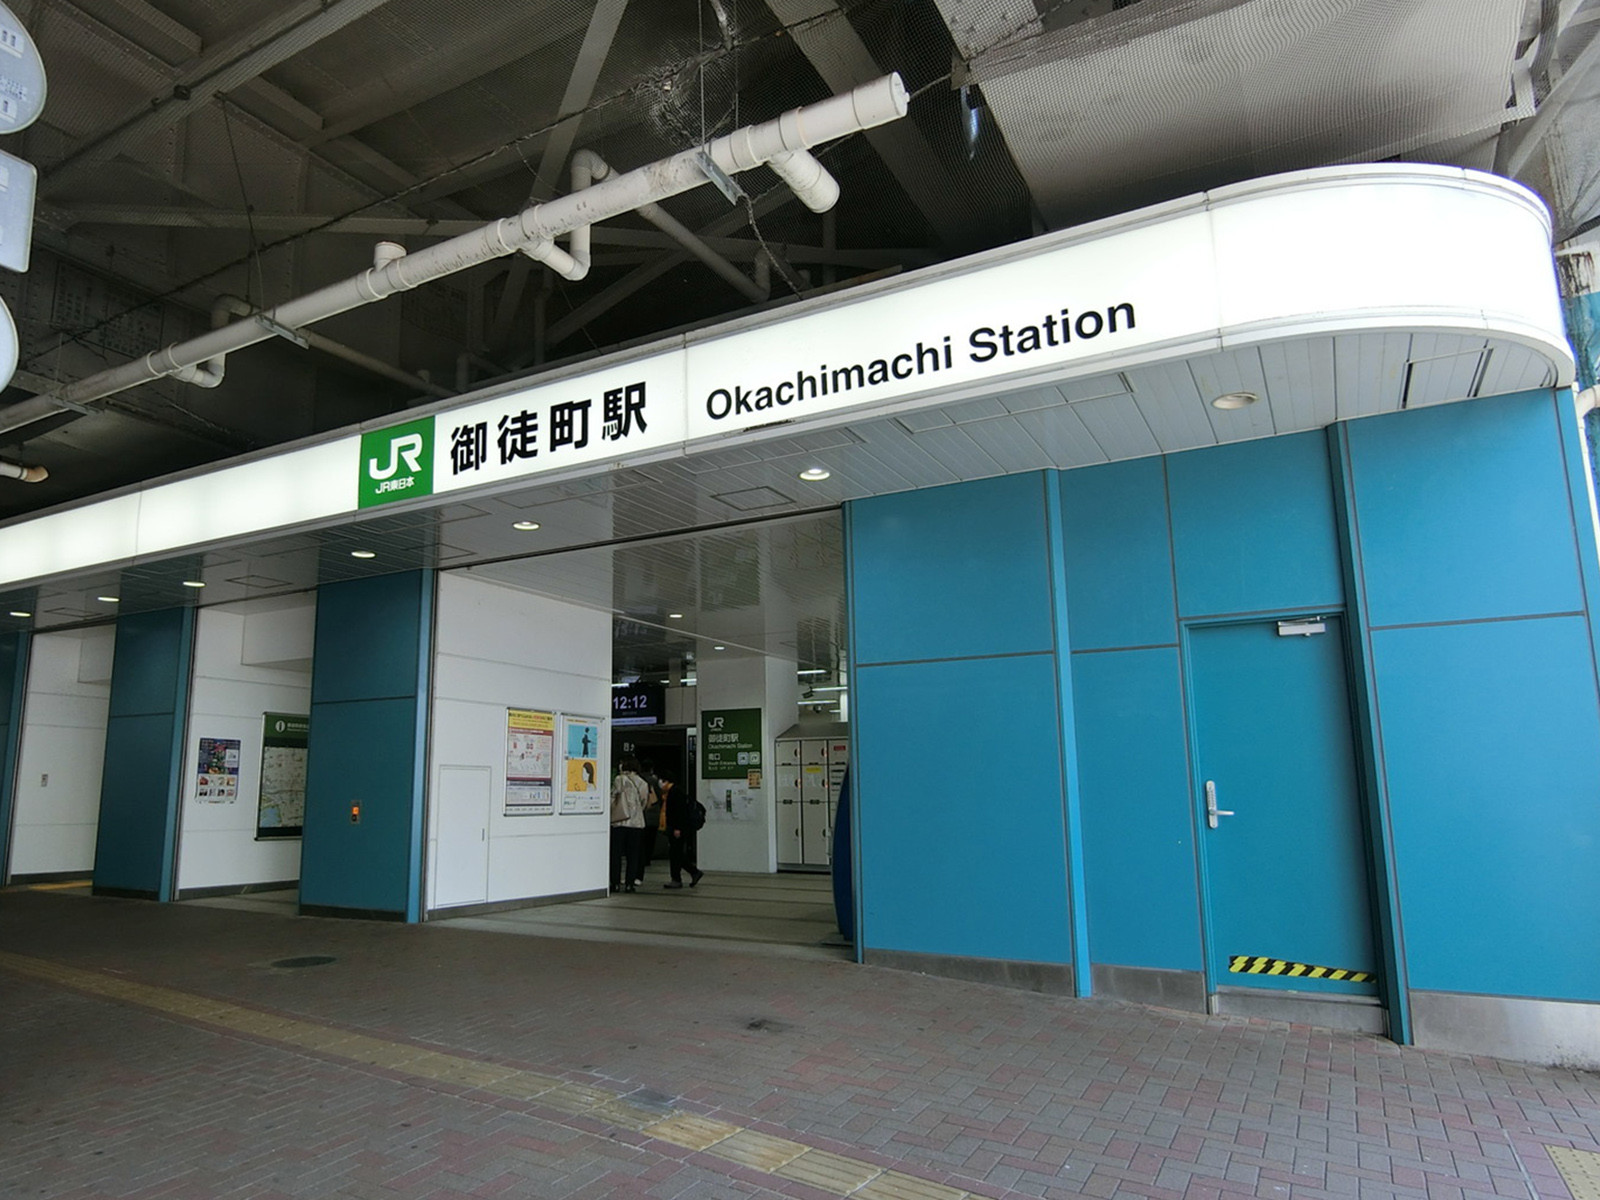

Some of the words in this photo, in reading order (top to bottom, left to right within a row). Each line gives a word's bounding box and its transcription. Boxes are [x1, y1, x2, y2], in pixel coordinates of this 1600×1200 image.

[705, 336, 953, 420] Okachimachi
[968, 302, 1137, 363] Station
[450, 381, 648, 475] 御徒町駅
[369, 433, 422, 479] JR
[375, 476, 415, 494] JR東日本
[613, 695, 647, 709] 12:12
[708, 717, 724, 728] JR
